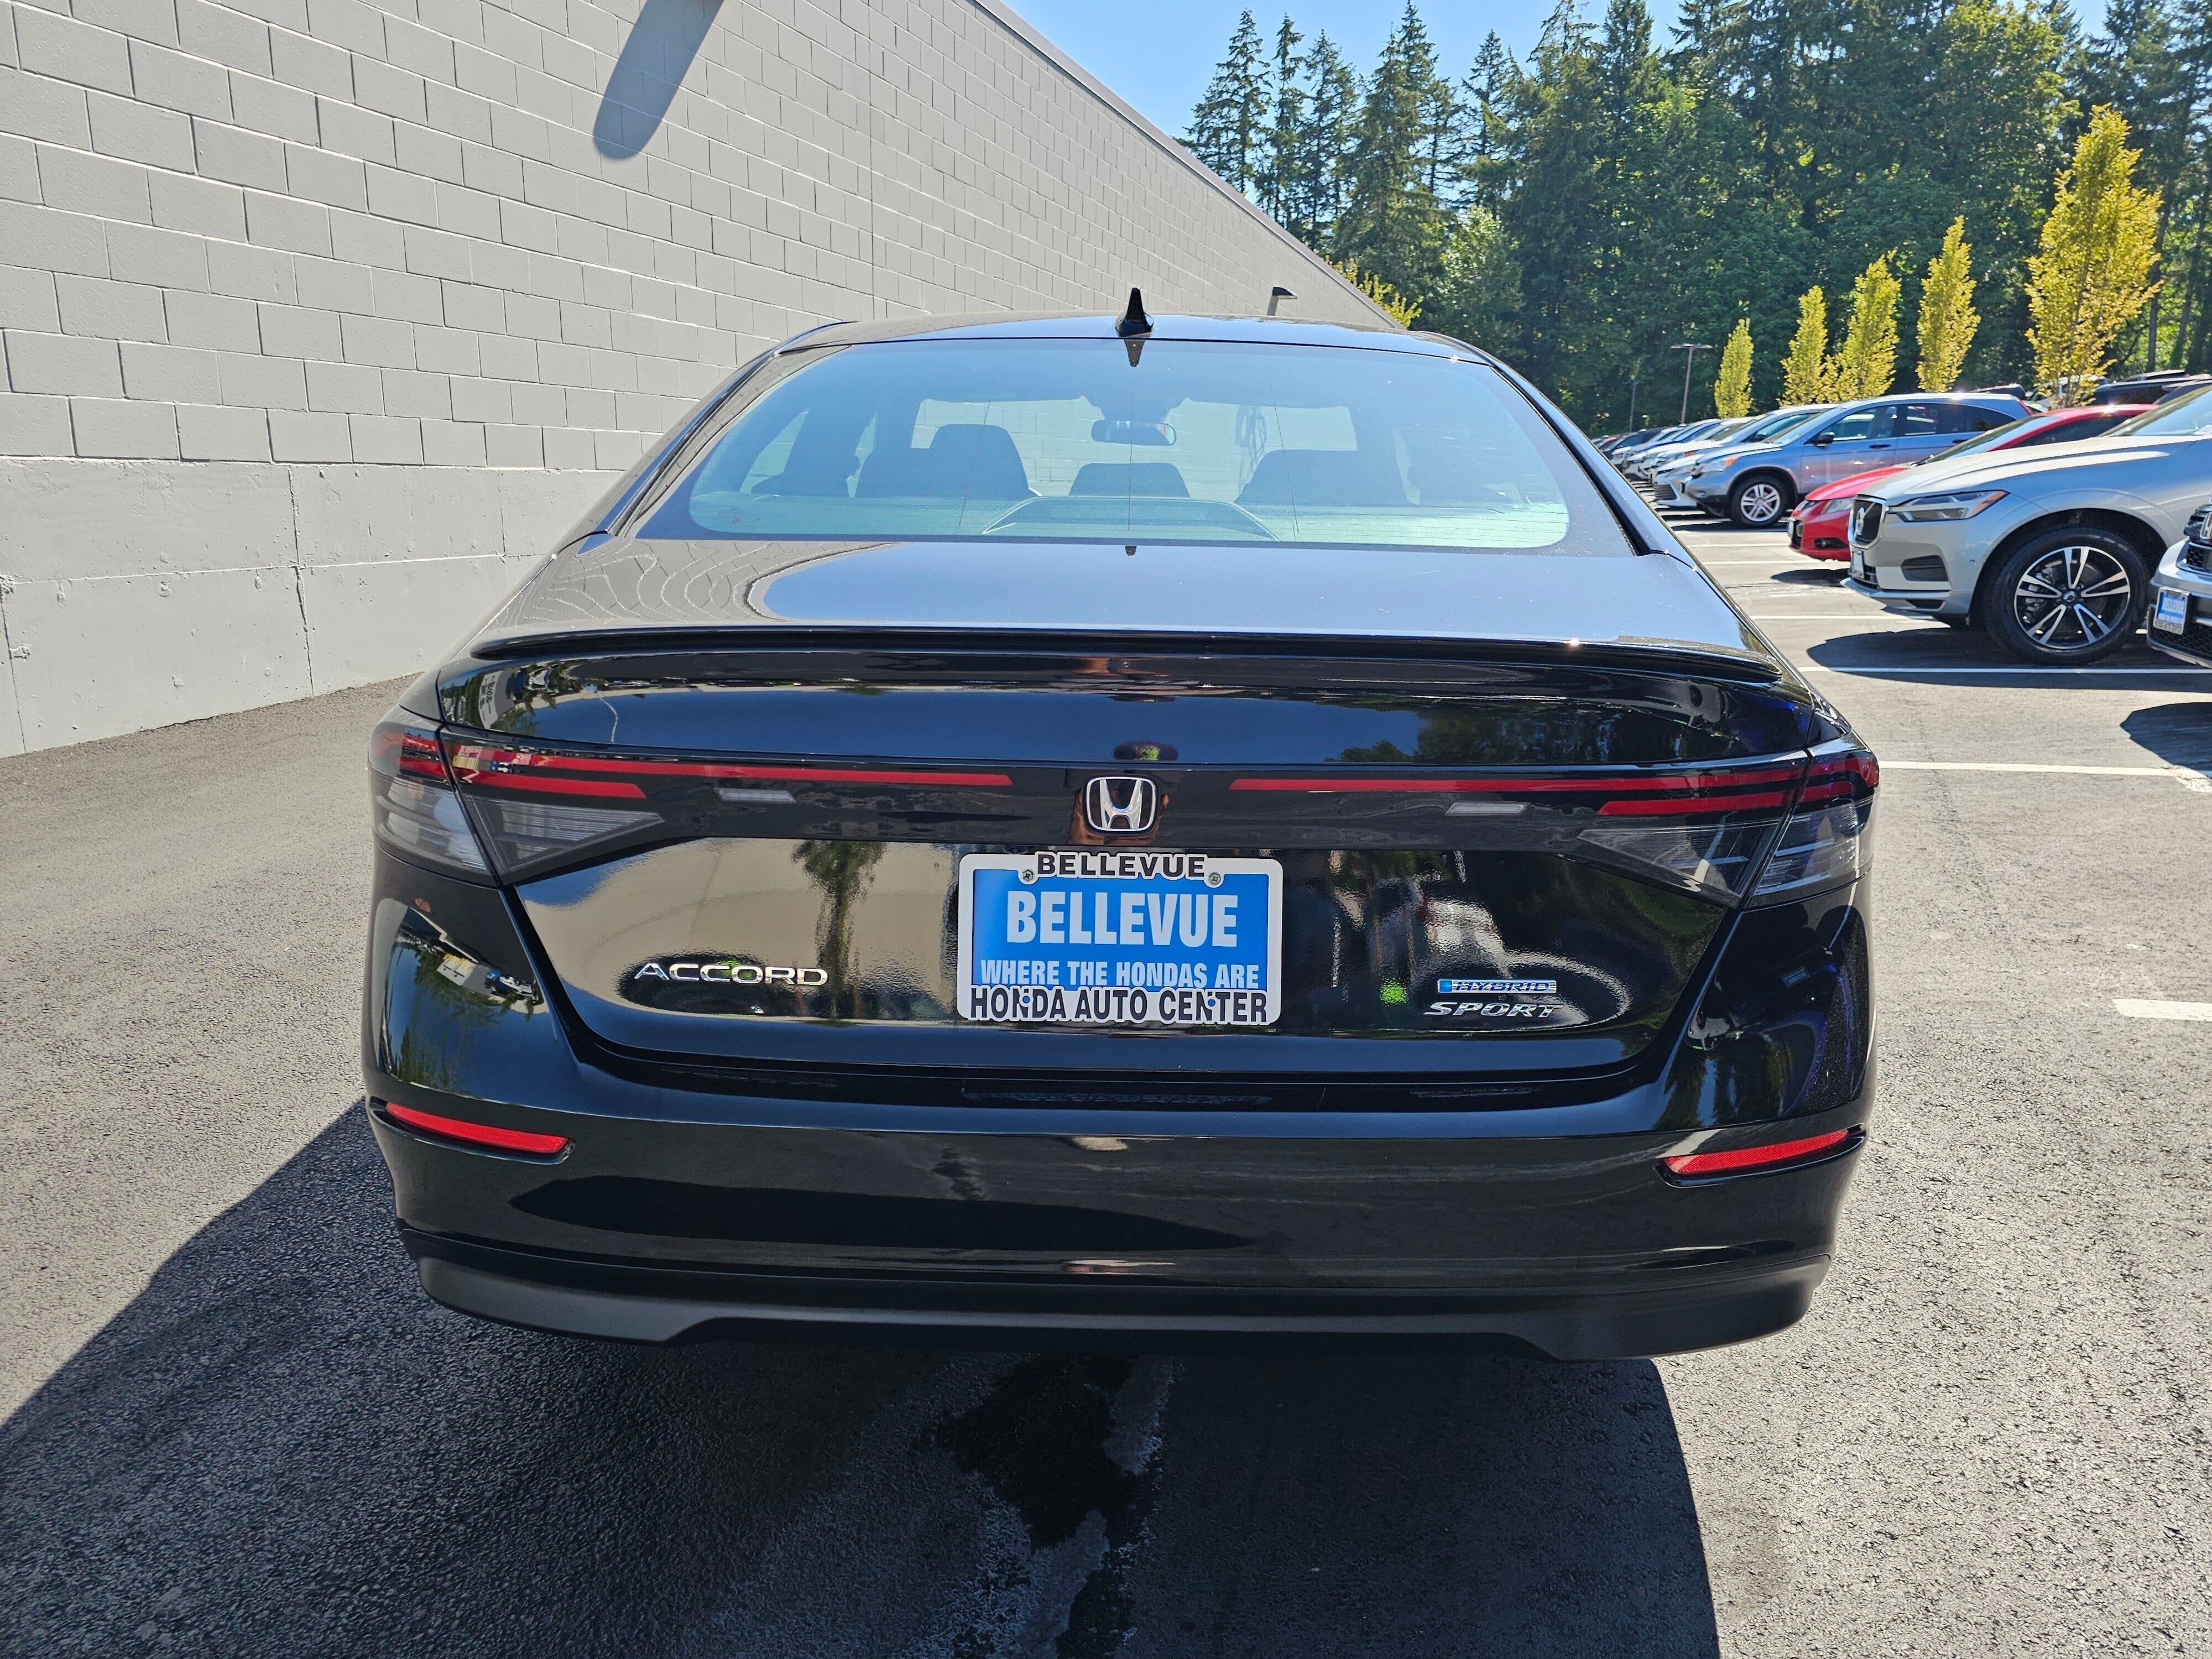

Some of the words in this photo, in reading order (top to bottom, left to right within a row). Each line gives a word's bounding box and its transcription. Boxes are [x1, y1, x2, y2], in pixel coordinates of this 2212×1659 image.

[1037, 854, 1206, 877] BELLEVUE
[1006, 891, 1238, 947] BELLEVUE
[634, 963, 828, 985] ACCORD
[981, 960, 1059, 985] WHERE
[1067, 961, 1108, 985] THE
[1116, 962, 1207, 988] HONDAS
[1214, 964, 1259, 989] ARE
[1454, 981, 1551, 992] HYBRID
[971, 987, 1067, 1019] HONDA
[1074, 989, 1147, 1020] AUTO
[1159, 990, 1267, 1022] CENTER
[1423, 1001, 1563, 1018] SPORT
